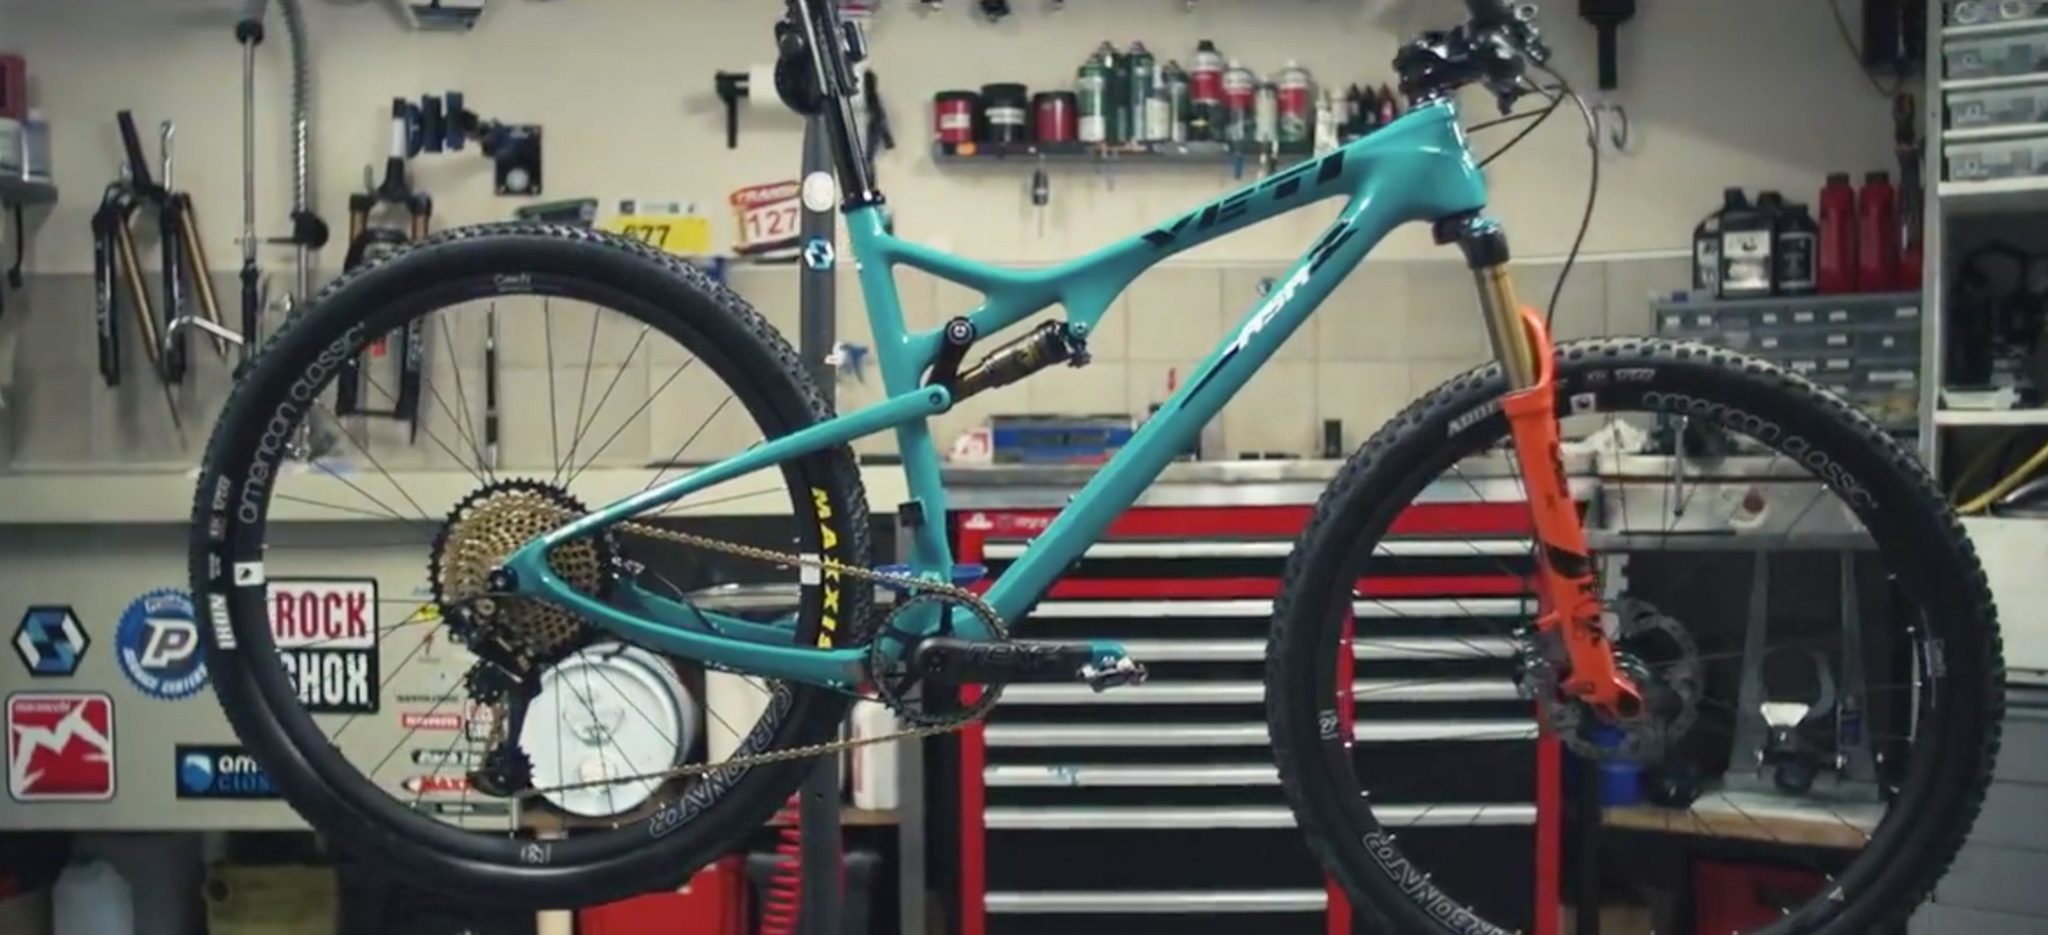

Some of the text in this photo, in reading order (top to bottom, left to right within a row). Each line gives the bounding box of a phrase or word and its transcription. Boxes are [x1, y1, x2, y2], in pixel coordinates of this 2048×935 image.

[749, 208, 798, 237] 127
[1141, 151, 1345, 248] YETI
[276, 591, 366, 638] ROCK
